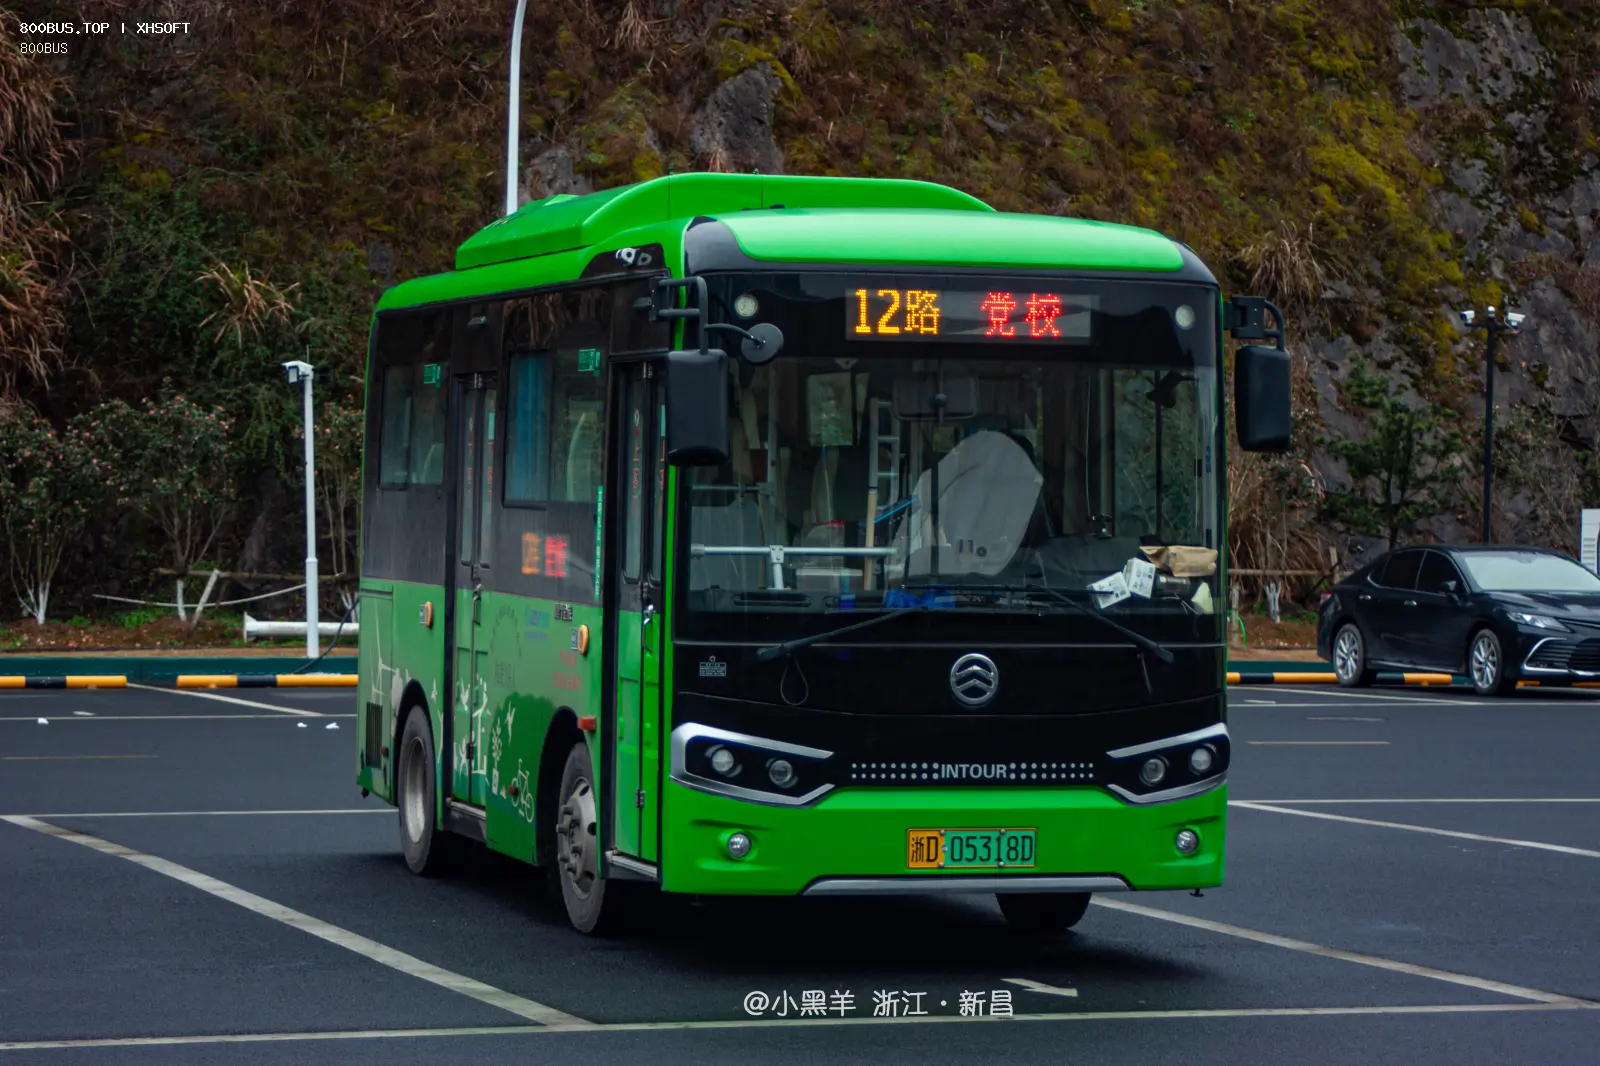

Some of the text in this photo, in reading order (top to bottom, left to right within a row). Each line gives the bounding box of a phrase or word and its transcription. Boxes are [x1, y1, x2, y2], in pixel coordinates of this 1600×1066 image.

[854, 289, 1062, 337] 12路 党校
[941, 763, 1008, 779] INTOUR
[910, 835, 1034, 863] 浙D 05318D
